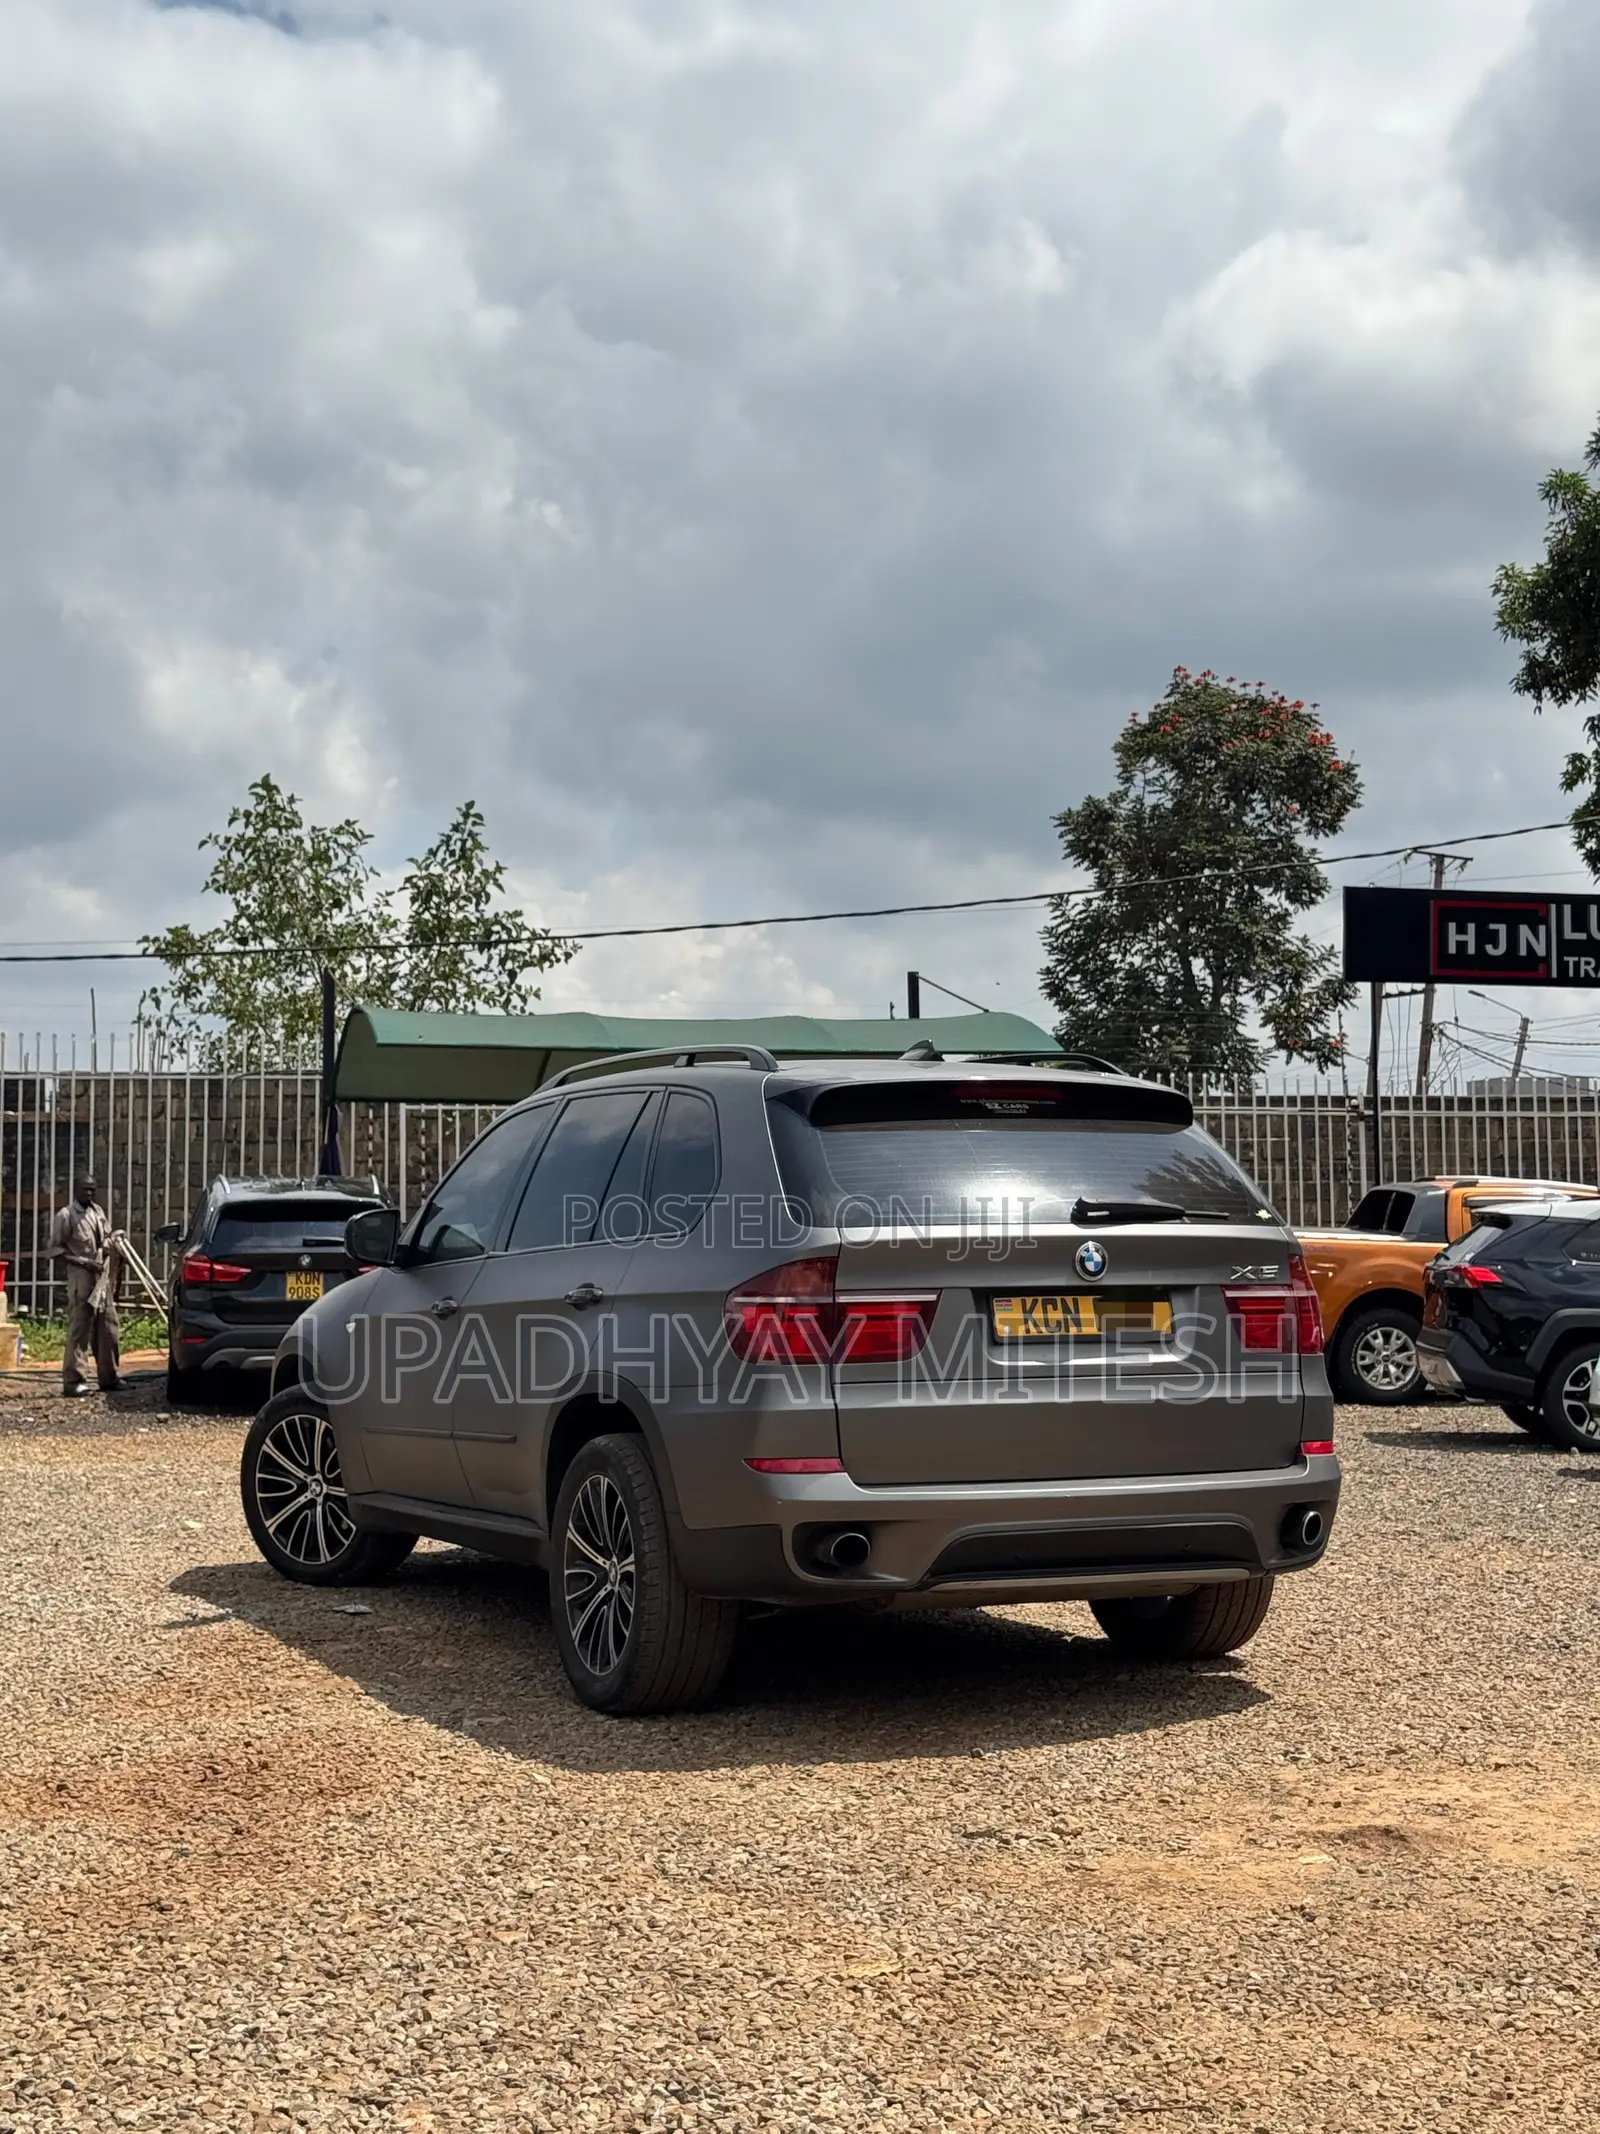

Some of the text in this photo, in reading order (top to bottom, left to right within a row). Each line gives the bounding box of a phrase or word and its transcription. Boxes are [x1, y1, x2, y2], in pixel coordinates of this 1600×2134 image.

[1448, 922, 1547, 957] HJN
[1563, 956, 1600, 978] TR
[295, 1271, 320, 1285] KDN
[288, 1286, 320, 1299] 908S
[1020, 1297, 1083, 1335] KCN
